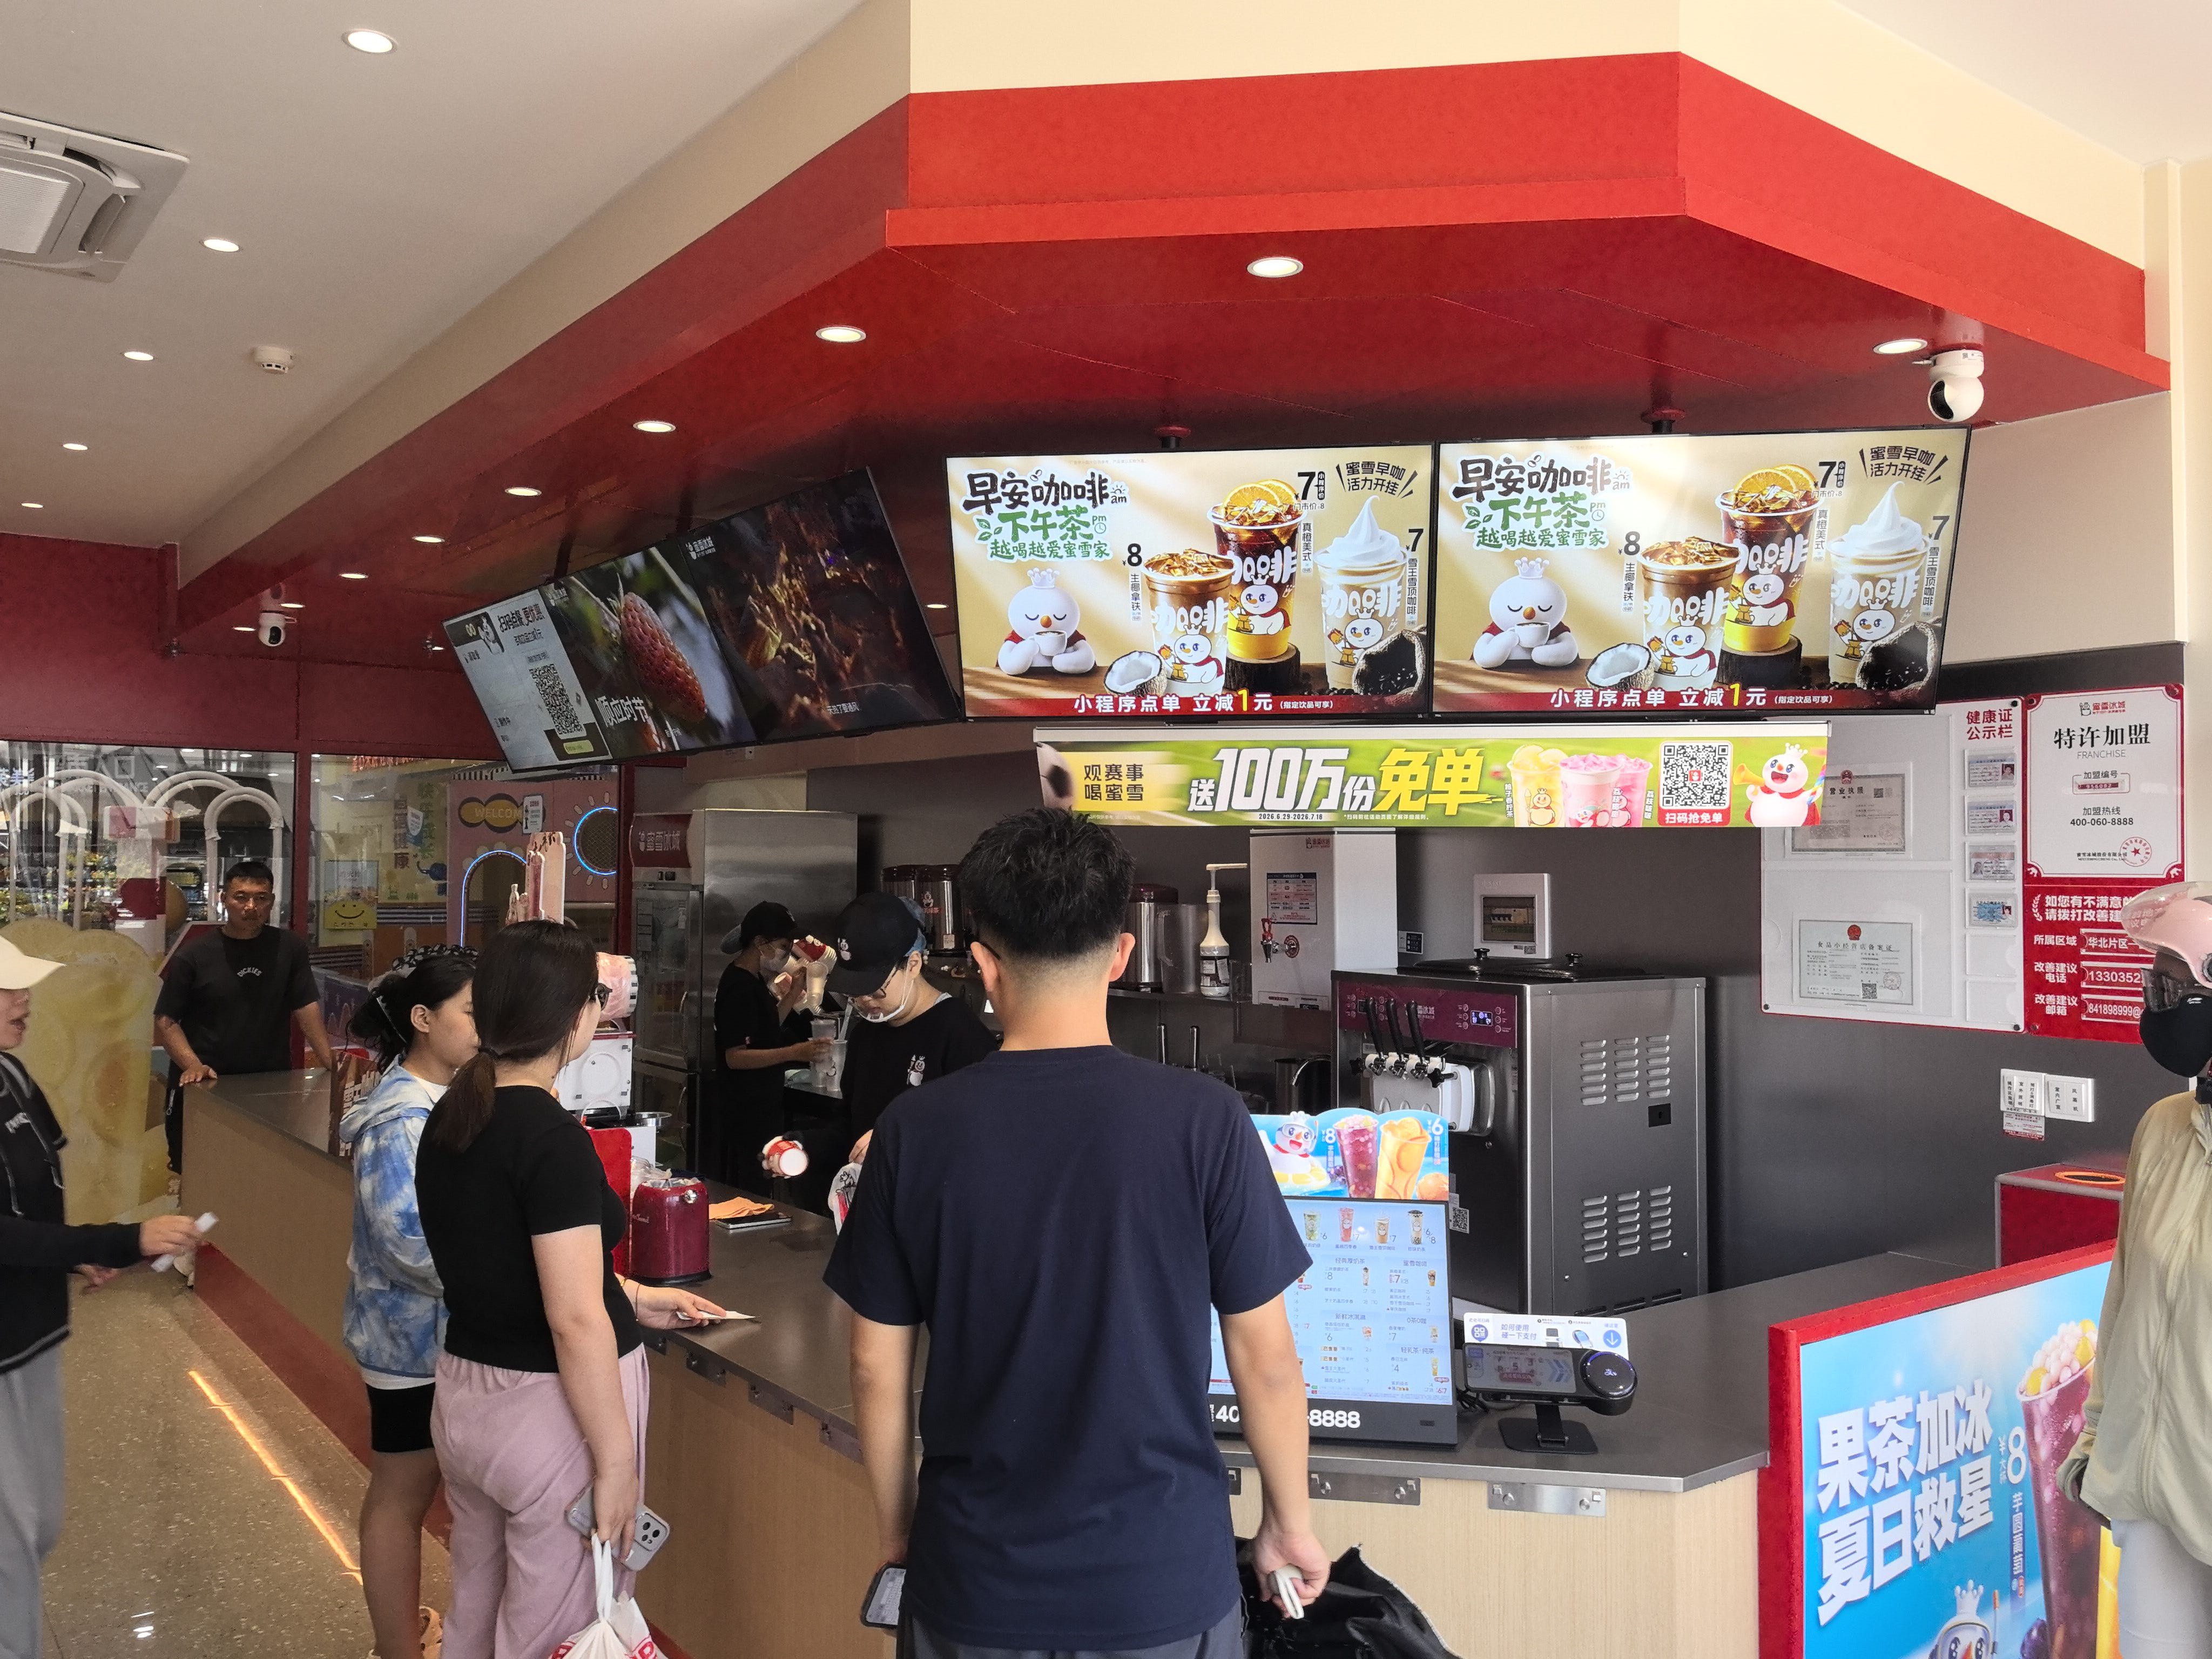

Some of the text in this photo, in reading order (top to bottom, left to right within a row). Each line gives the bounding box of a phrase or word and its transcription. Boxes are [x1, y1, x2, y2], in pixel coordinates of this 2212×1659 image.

[1870, 446, 1935, 466] 蜜雪早咖
[1345, 461, 1406, 481] 蜜雪早咖
[1452, 457, 1612, 502] 早安咖啡
[1870, 461, 1927, 482] 活力开挂
[962, 471, 1109, 515] 早安咖啡
[1347, 476, 1399, 496] 活力开挂
[1613, 481, 1630, 490] am
[1111, 495, 1127, 503] am
[1590, 502, 1606, 512] pm
[1092, 515, 1107, 524] pm
[1489, 491, 1590, 531] 下午茶
[998, 504, 1094, 541] 下午茶
[1815, 509, 1828, 550] 真橙美式
[1476, 527, 1606, 548] 越喝越爱蜜雪家
[989, 539, 1109, 560] 越喝越爱蜜雪家
[1407, 558, 1418, 615] 雪王雪顶咖啡
[1623, 563, 1635, 602] 生椰拿铁
[1923, 547, 1940, 606] 雪王雪顶咖啡
[1130, 574, 1141, 611] 生椰拿铁
[1074, 693, 1180, 713] 小程序点单
[1193, 689, 1273, 712] 立减1元
[1550, 688, 1665, 708] 小程序点单
[1679, 683, 1766, 707] 立减1元
[595, 694, 648, 728] 顺应时节
[1966, 709, 2013, 725] 健康证
[1966, 724, 2013, 740] 公示栏
[2053, 723, 2151, 749] 特许加盟
[2077, 750, 2126, 759] FRANCHISE
[1084, 763, 1144, 781] 观赛事
[2083, 770, 2118, 779] 加盟编号
[1084, 783, 1144, 801] 喝蜜雪
[1665, 812, 1723, 824] 扫码抢免单
[2082, 806, 2121, 816] 加盟热线
[2070, 818, 2134, 826] 400-060-8888
[2033, 934, 2142, 949] 所属区域 华北片区一
[2034, 962, 2078, 974] 改善建议
[2045, 973, 2067, 983] 电话
[2089, 970, 2142, 983] 1330352
[2034, 994, 2078, 1007] 改善建议
[2045, 1006, 2067, 1016] 邮箱
[1501, 1331, 1537, 1340] 碰一下支付
[1818, 1378, 1993, 1513] 果茶加冰
[1818, 1454, 1994, 1626] 夏日救星
